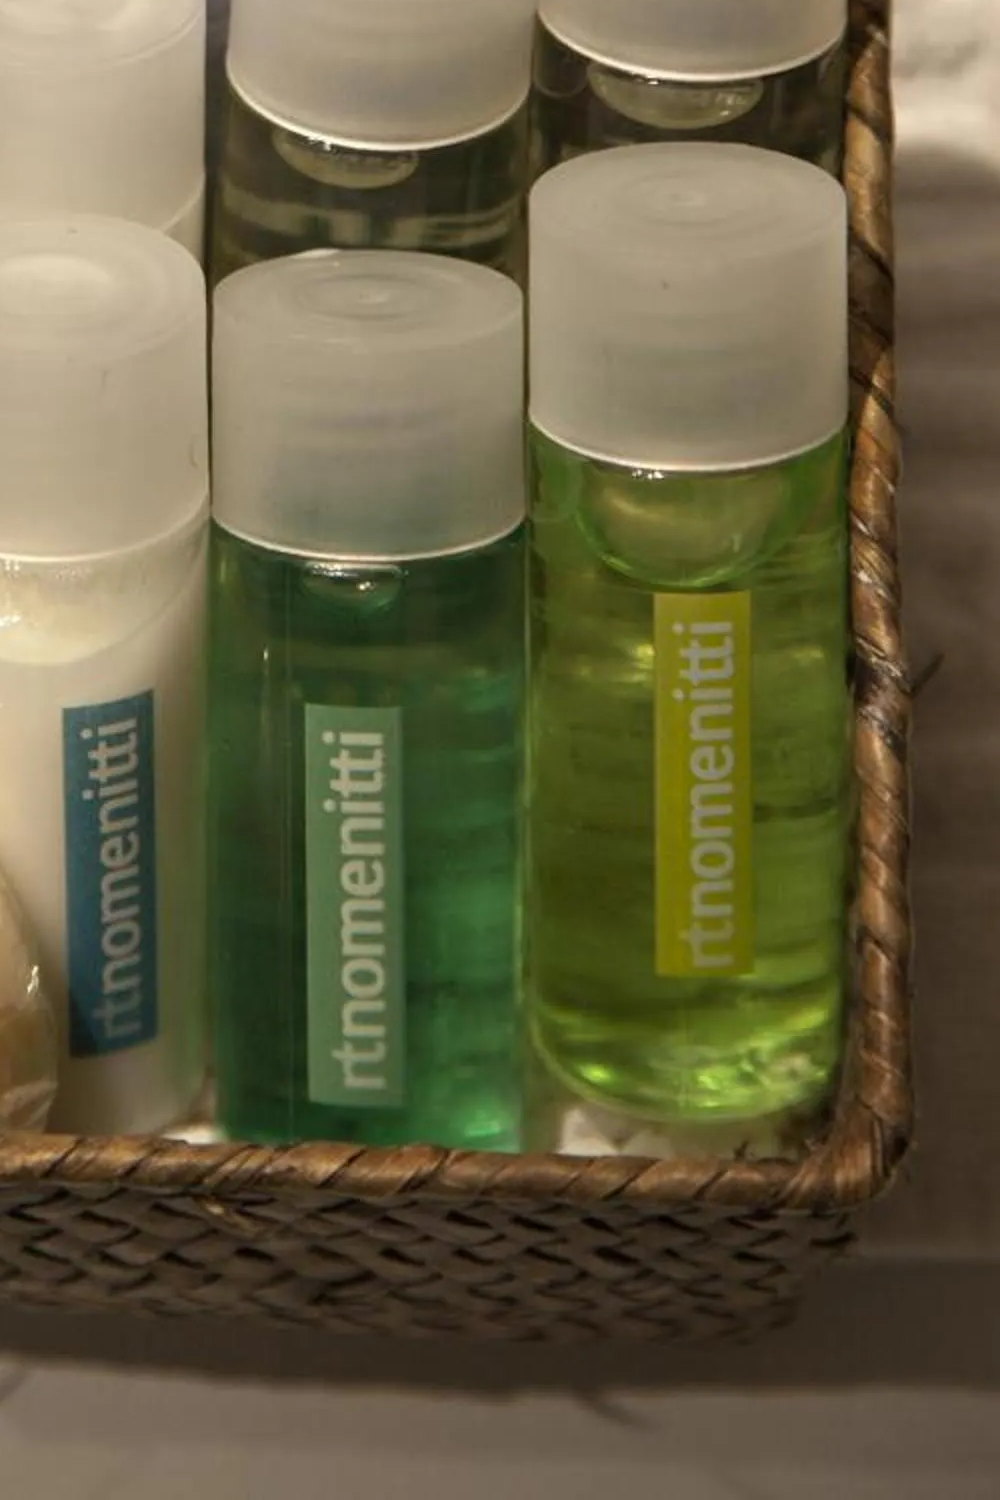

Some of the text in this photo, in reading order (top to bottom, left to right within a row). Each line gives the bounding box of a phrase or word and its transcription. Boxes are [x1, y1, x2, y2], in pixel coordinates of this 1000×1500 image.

[79, 716, 144, 1040] rtnomenitti
[321, 730, 388, 1090] rtnomenitti
[671, 620, 735, 969] rtnomenitti
